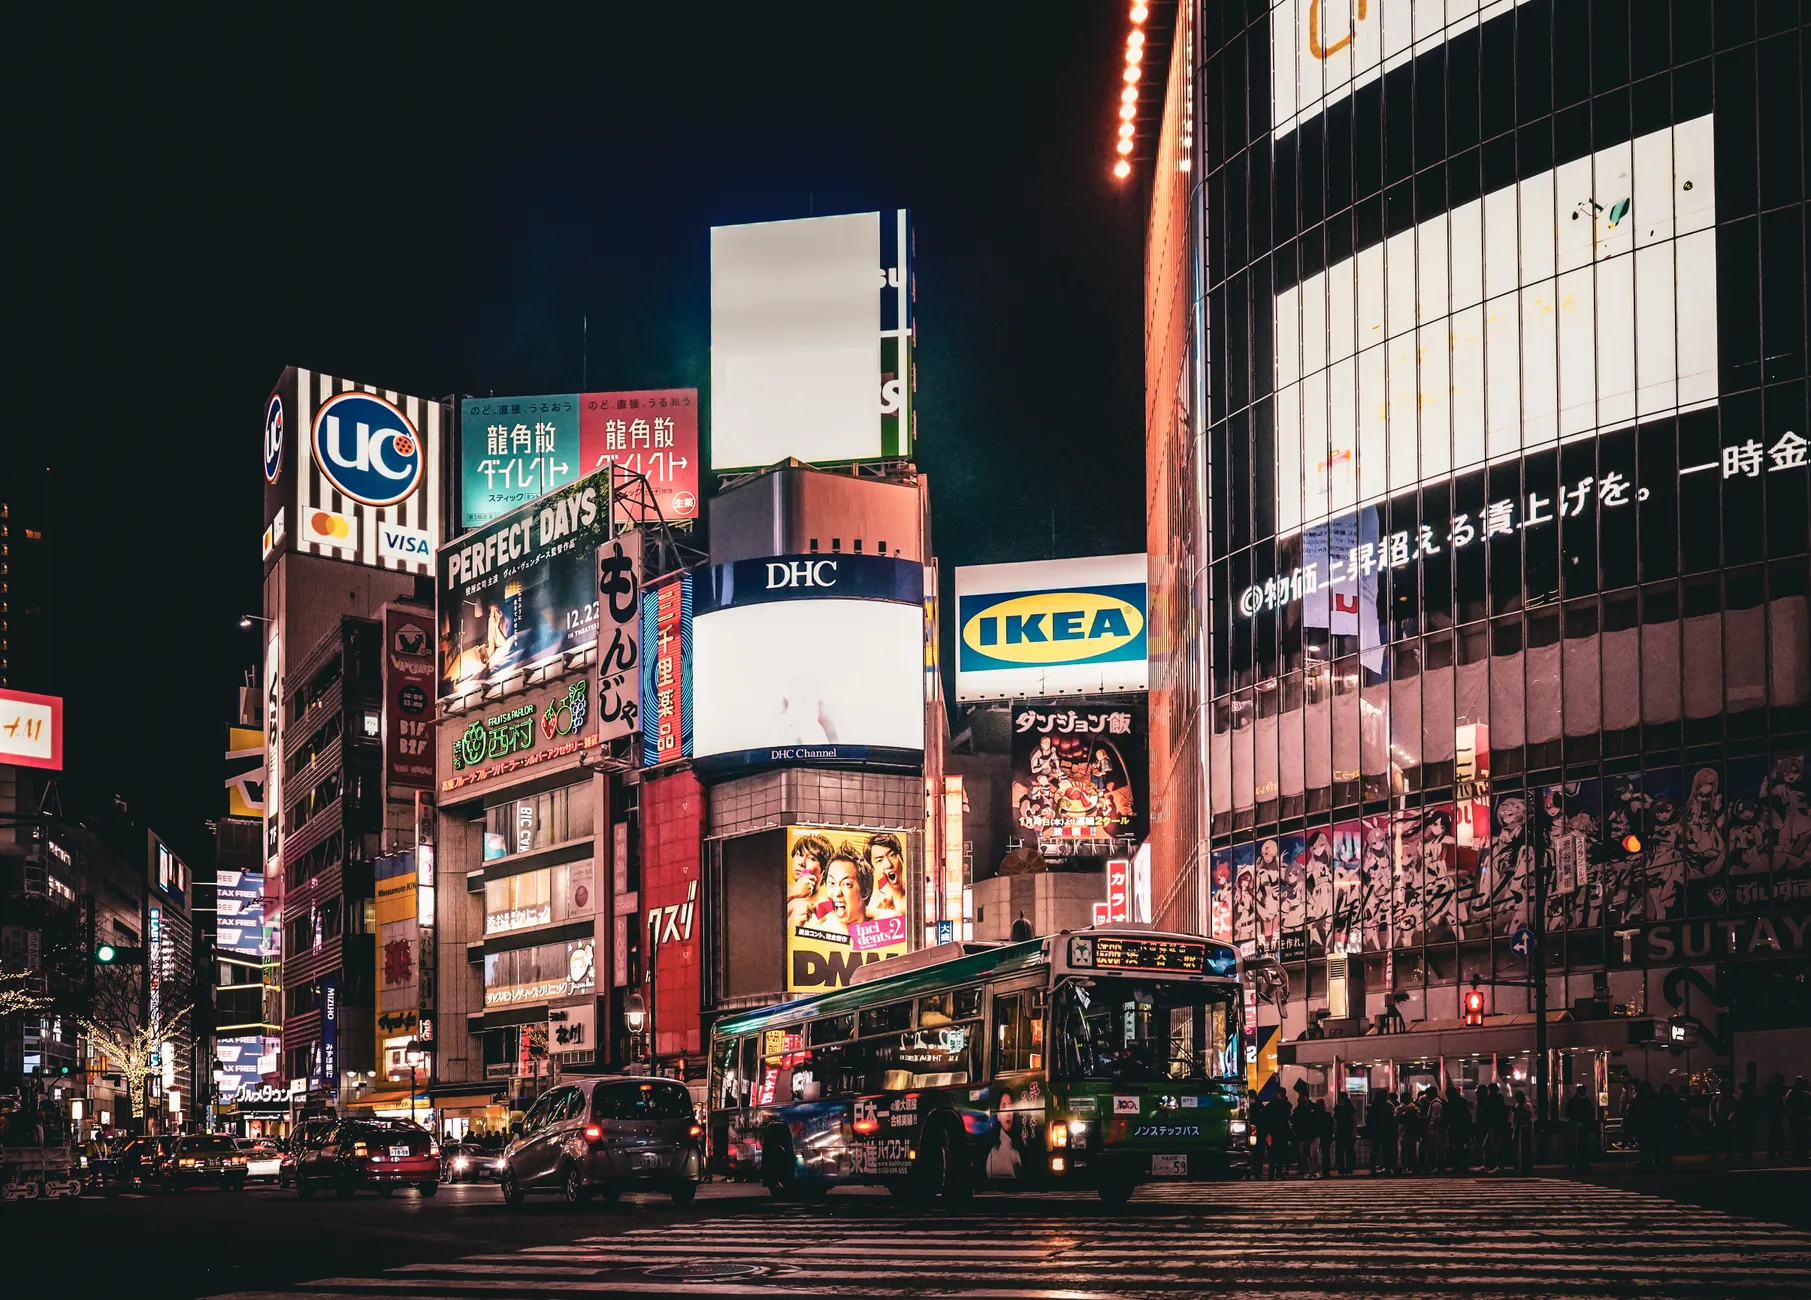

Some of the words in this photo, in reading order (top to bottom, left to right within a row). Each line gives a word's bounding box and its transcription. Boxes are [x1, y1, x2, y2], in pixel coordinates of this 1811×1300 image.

[487, 421, 556, 455] 龍角散
[606, 416, 675, 450] 龍角散
[1679, 431, 1811, 479] 一時金
[477, 455, 569, 489] ダイレクト
[384, 531, 429, 556] VISA
[448, 518, 533, 590] PERFECT
[540, 487, 597, 548] DAYS
[766, 560, 837, 589] DHC
[599, 542, 638, 730] もんじゃ
[979, 608, 1132, 646] IKEA
[657, 590, 674, 752] 三千里薬品
[399, 719, 426, 736] B1F
[1015, 710, 1131, 734] ダンジョン飯
[399, 738, 427, 755] B2F
[489, 718, 533, 759] 西村
[771, 748, 794, 760] DHC
[797, 747, 837, 759] Channel
[235, 890, 257, 898] FREE
[235, 919, 257, 927] FREE
[856, 922, 880, 935] Inci
[327, 987, 335, 1020] MIZUHO
[1134, 1126, 1200, 1136] ノンステップバス
[850, 1140, 877, 1174] 東進
[1174, 1161, 1186, 1174] 59
